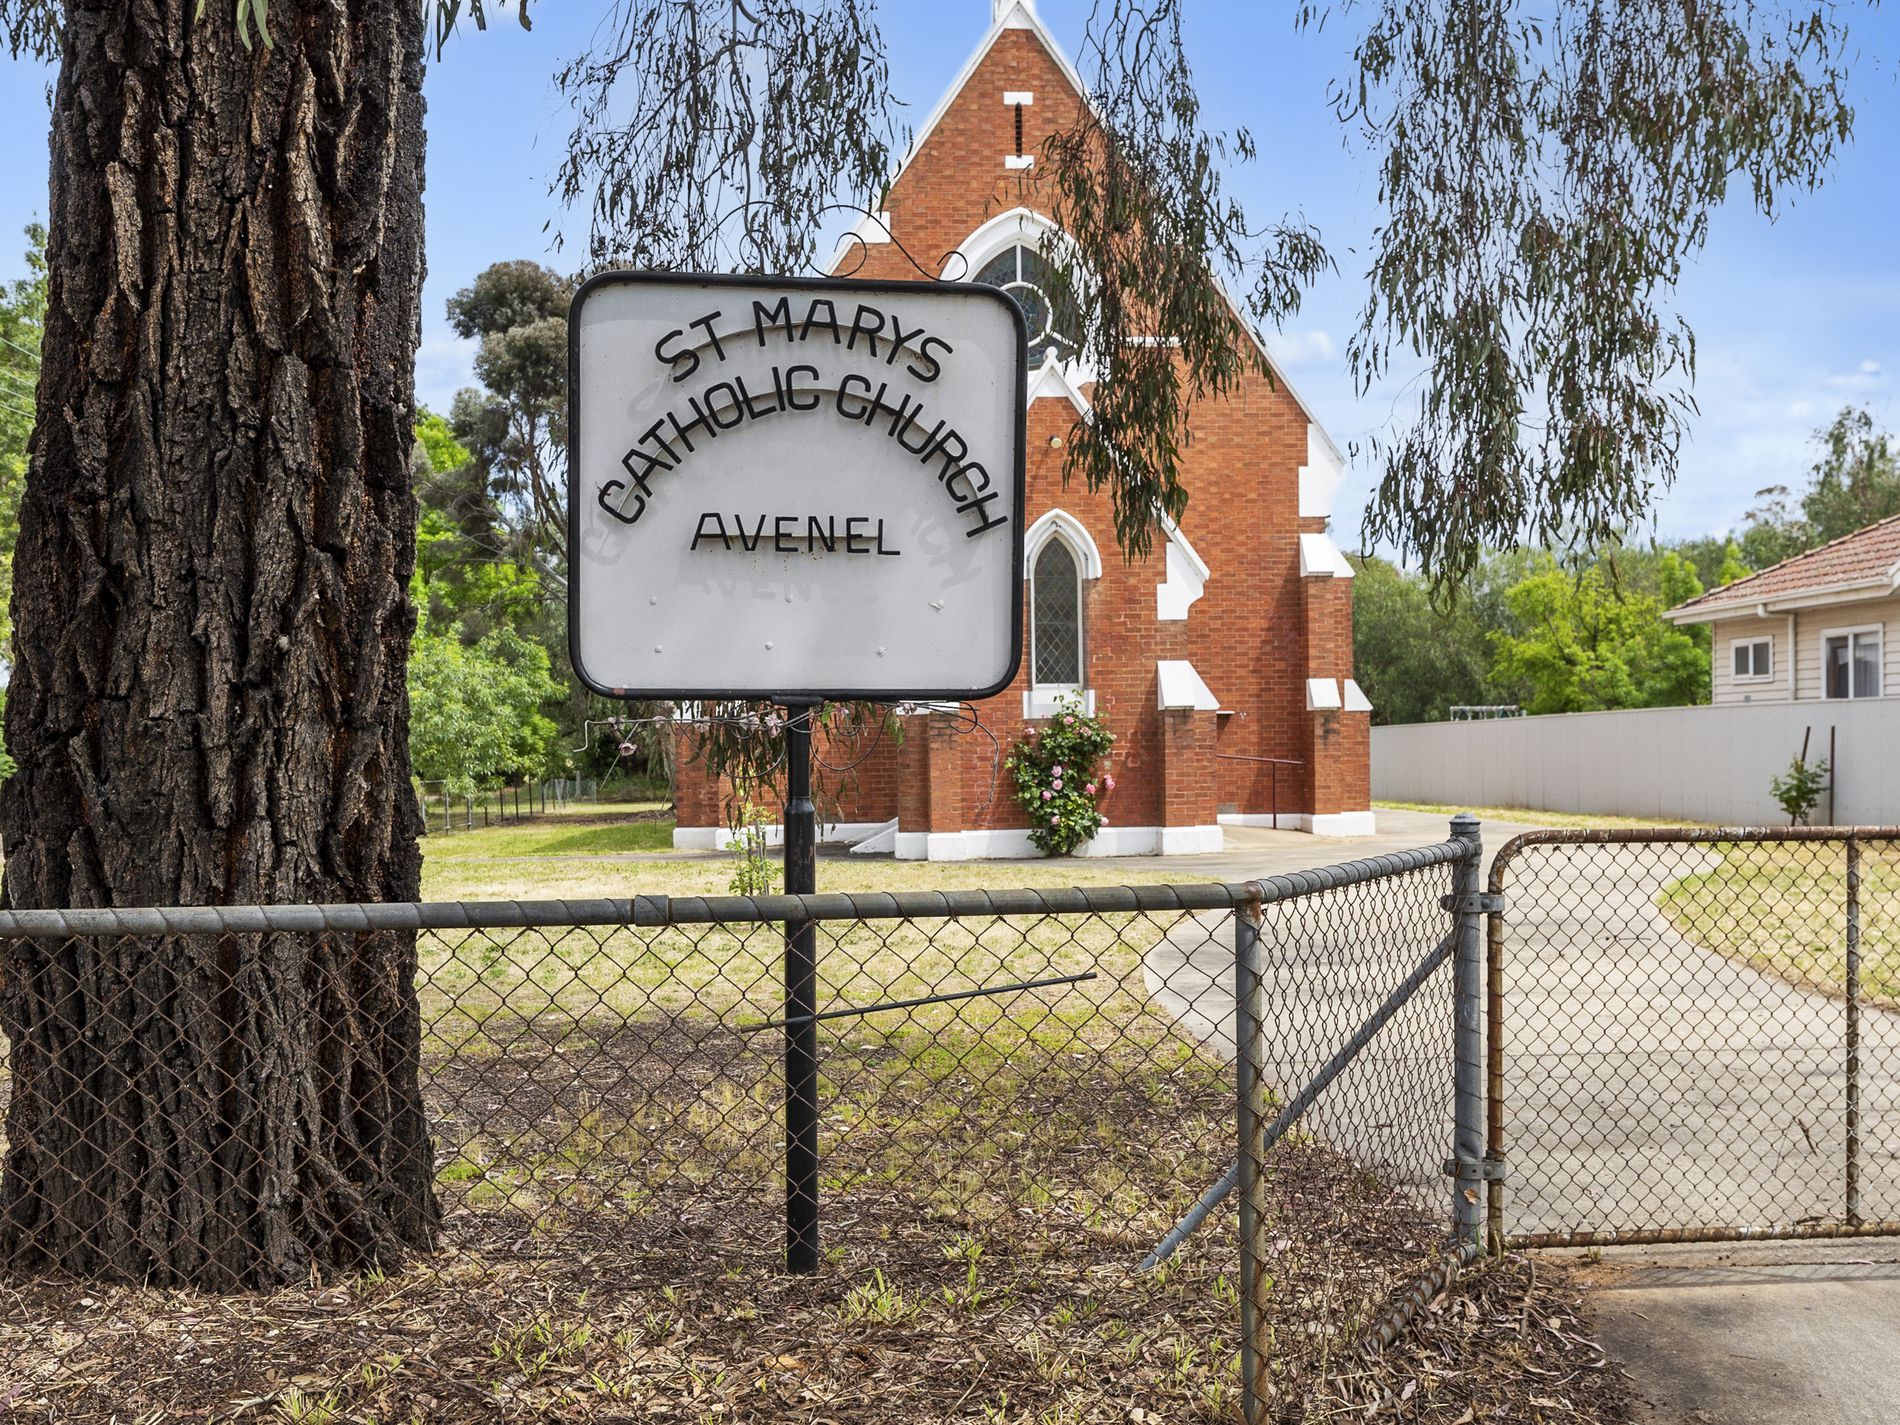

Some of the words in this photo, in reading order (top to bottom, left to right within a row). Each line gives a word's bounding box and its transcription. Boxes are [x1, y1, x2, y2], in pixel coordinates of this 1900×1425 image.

[654, 311, 726, 383] ST
[752, 296, 953, 383] MARYS
[598, 365, 820, 524] CATHOLIC
[836, 373, 1009, 538] CHURCH
[690, 512, 901, 556] AVENEL
